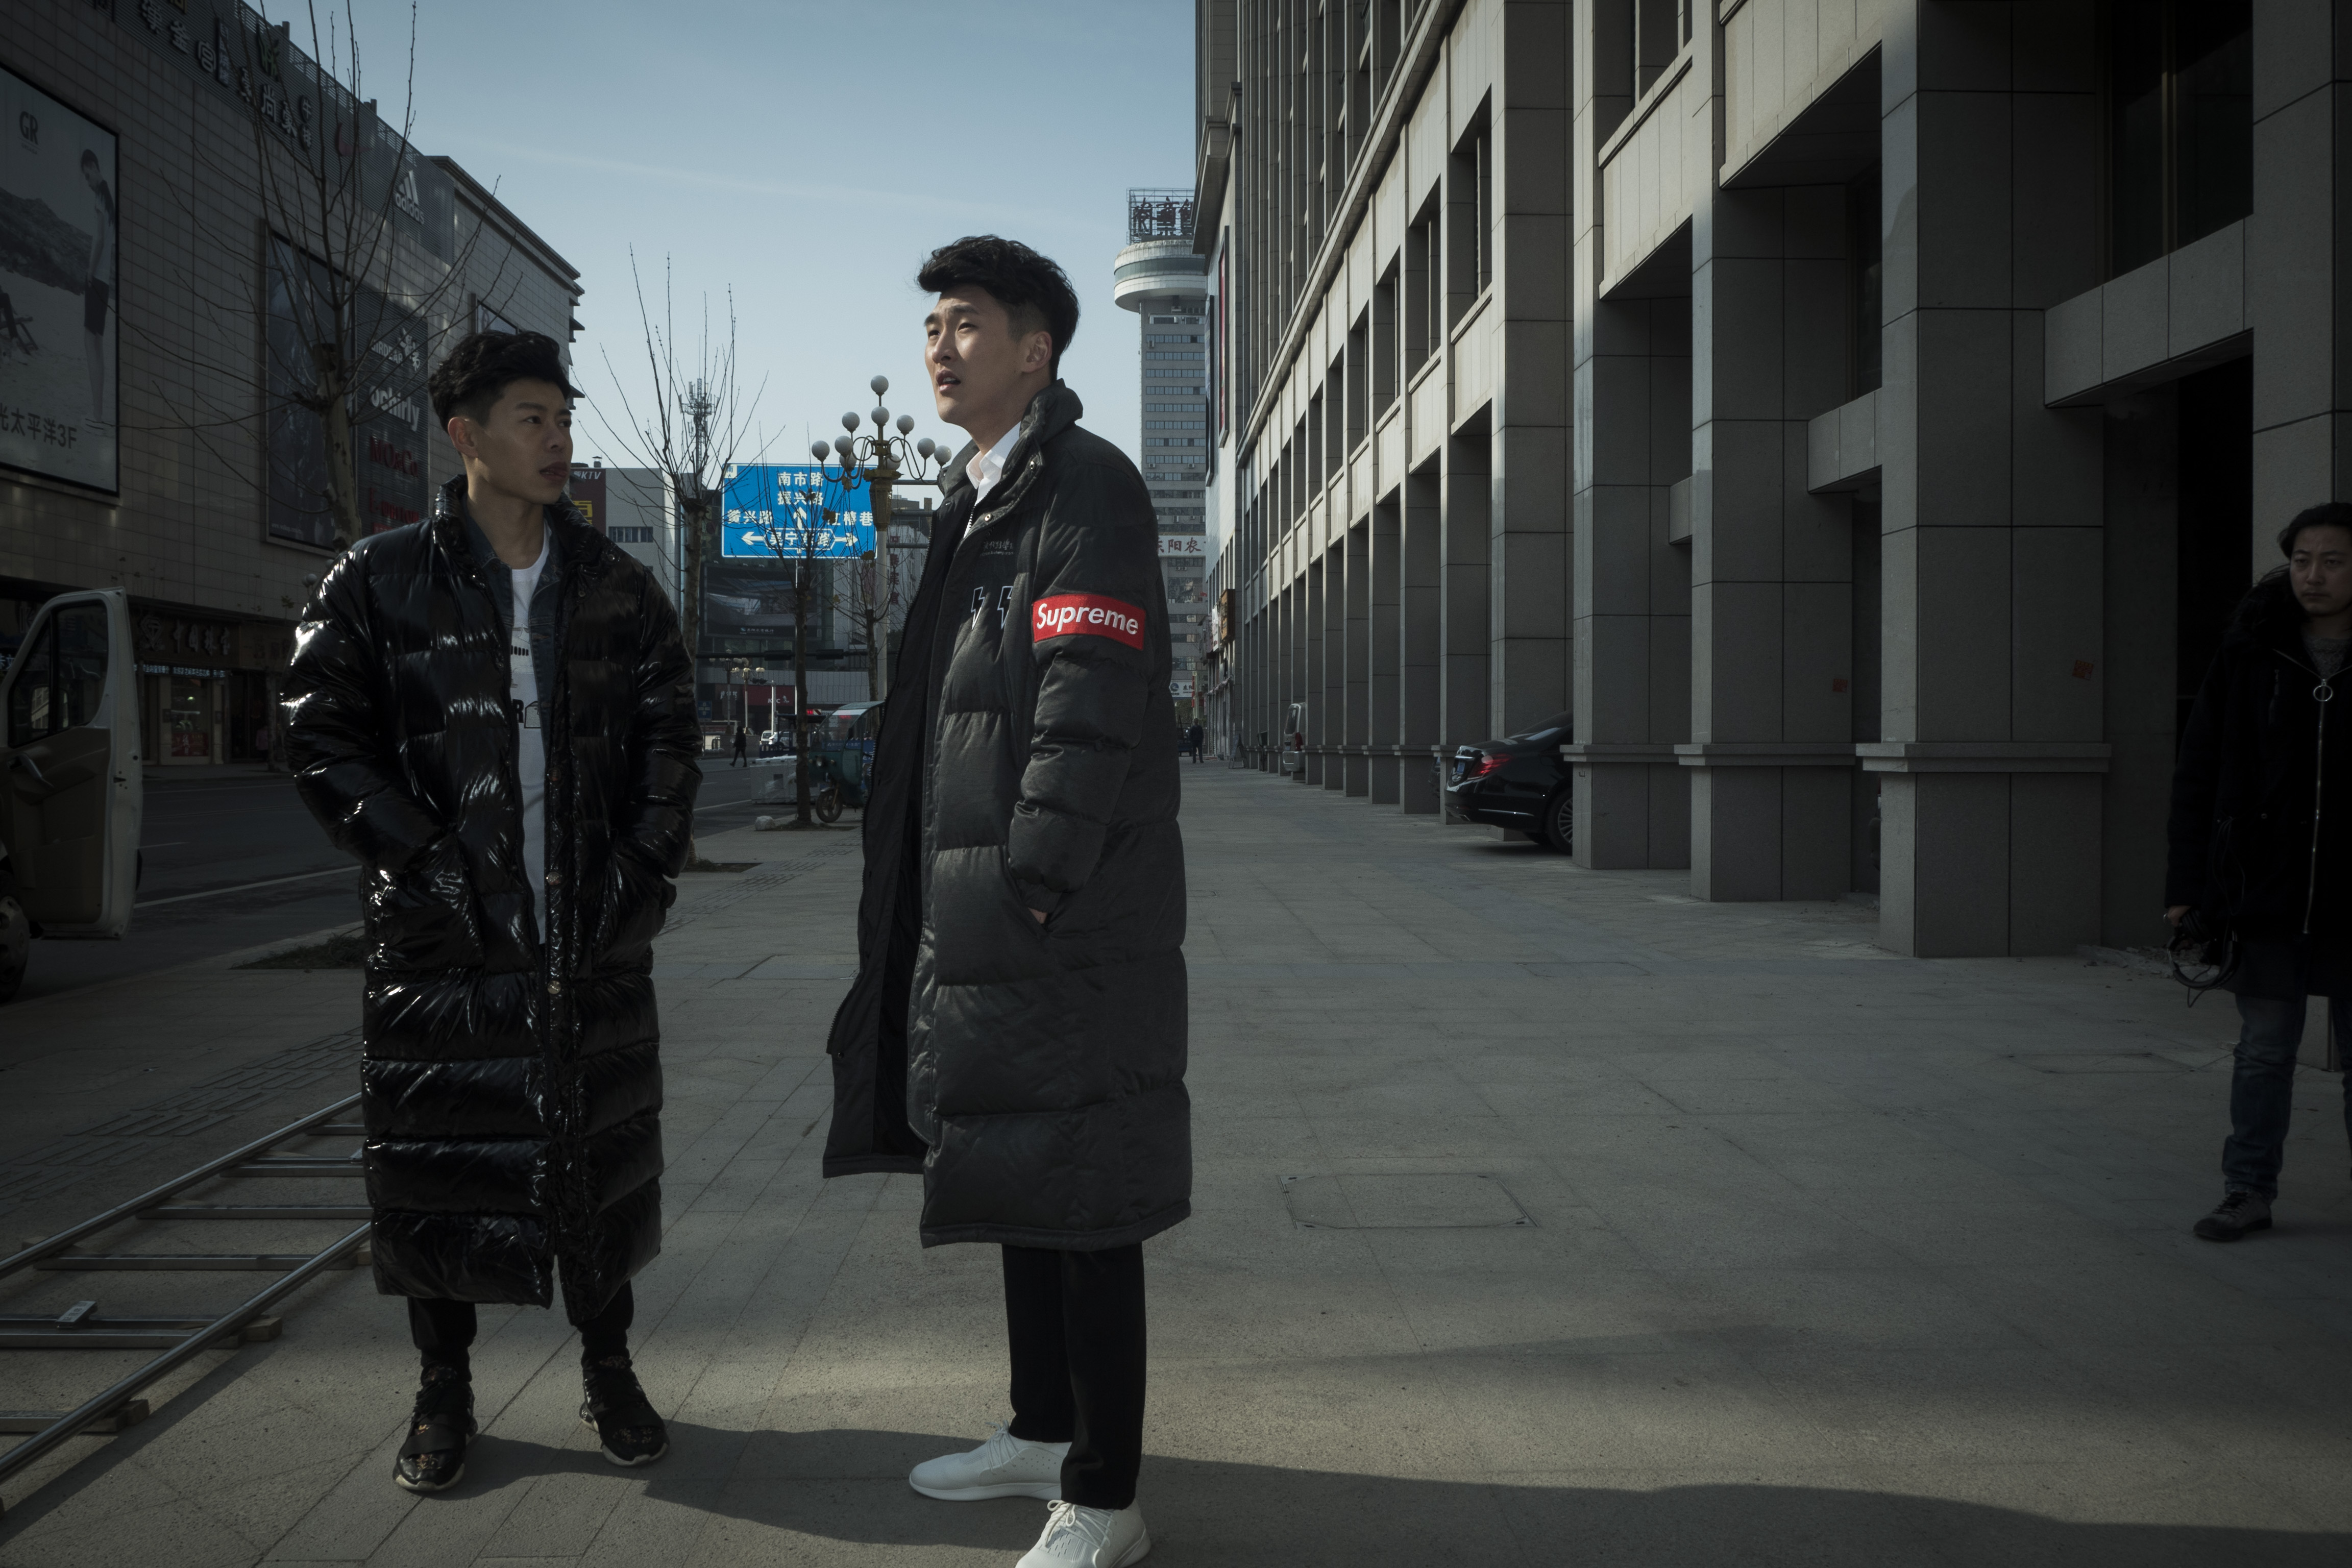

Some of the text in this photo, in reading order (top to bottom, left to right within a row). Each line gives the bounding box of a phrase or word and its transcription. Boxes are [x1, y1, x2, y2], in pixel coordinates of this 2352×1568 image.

[19, 111, 39, 145] GR
[395, 192, 425, 225] adidas
[777, 472, 824, 487] 南市路
[777, 491, 824, 506] 振兴路
[1158, 537, 1206, 553] 阳农
[1037, 603, 1138, 634] Supreme
